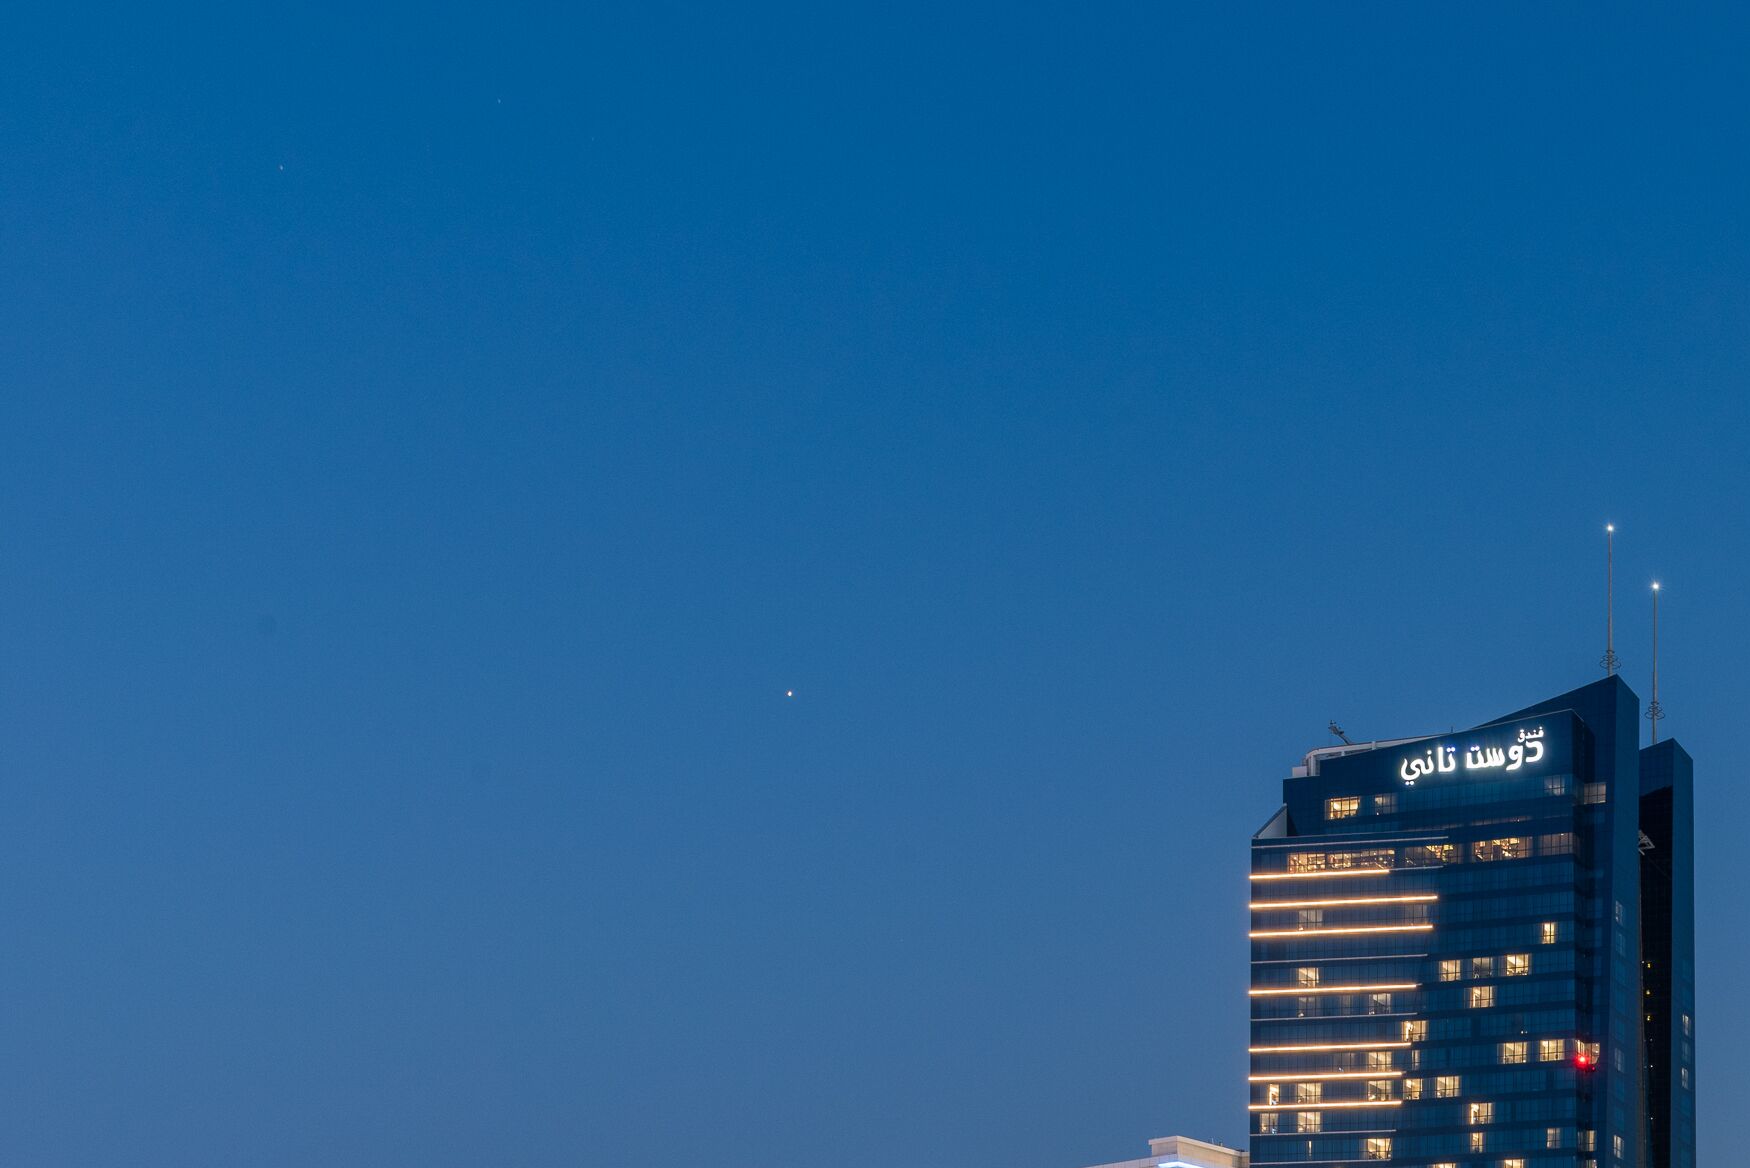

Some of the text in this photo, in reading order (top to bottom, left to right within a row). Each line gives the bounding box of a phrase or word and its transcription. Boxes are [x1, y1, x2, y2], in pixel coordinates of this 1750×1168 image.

[1517, 726, 1545, 743] فندق
[1400, 740, 1545, 786] دوست تاني
